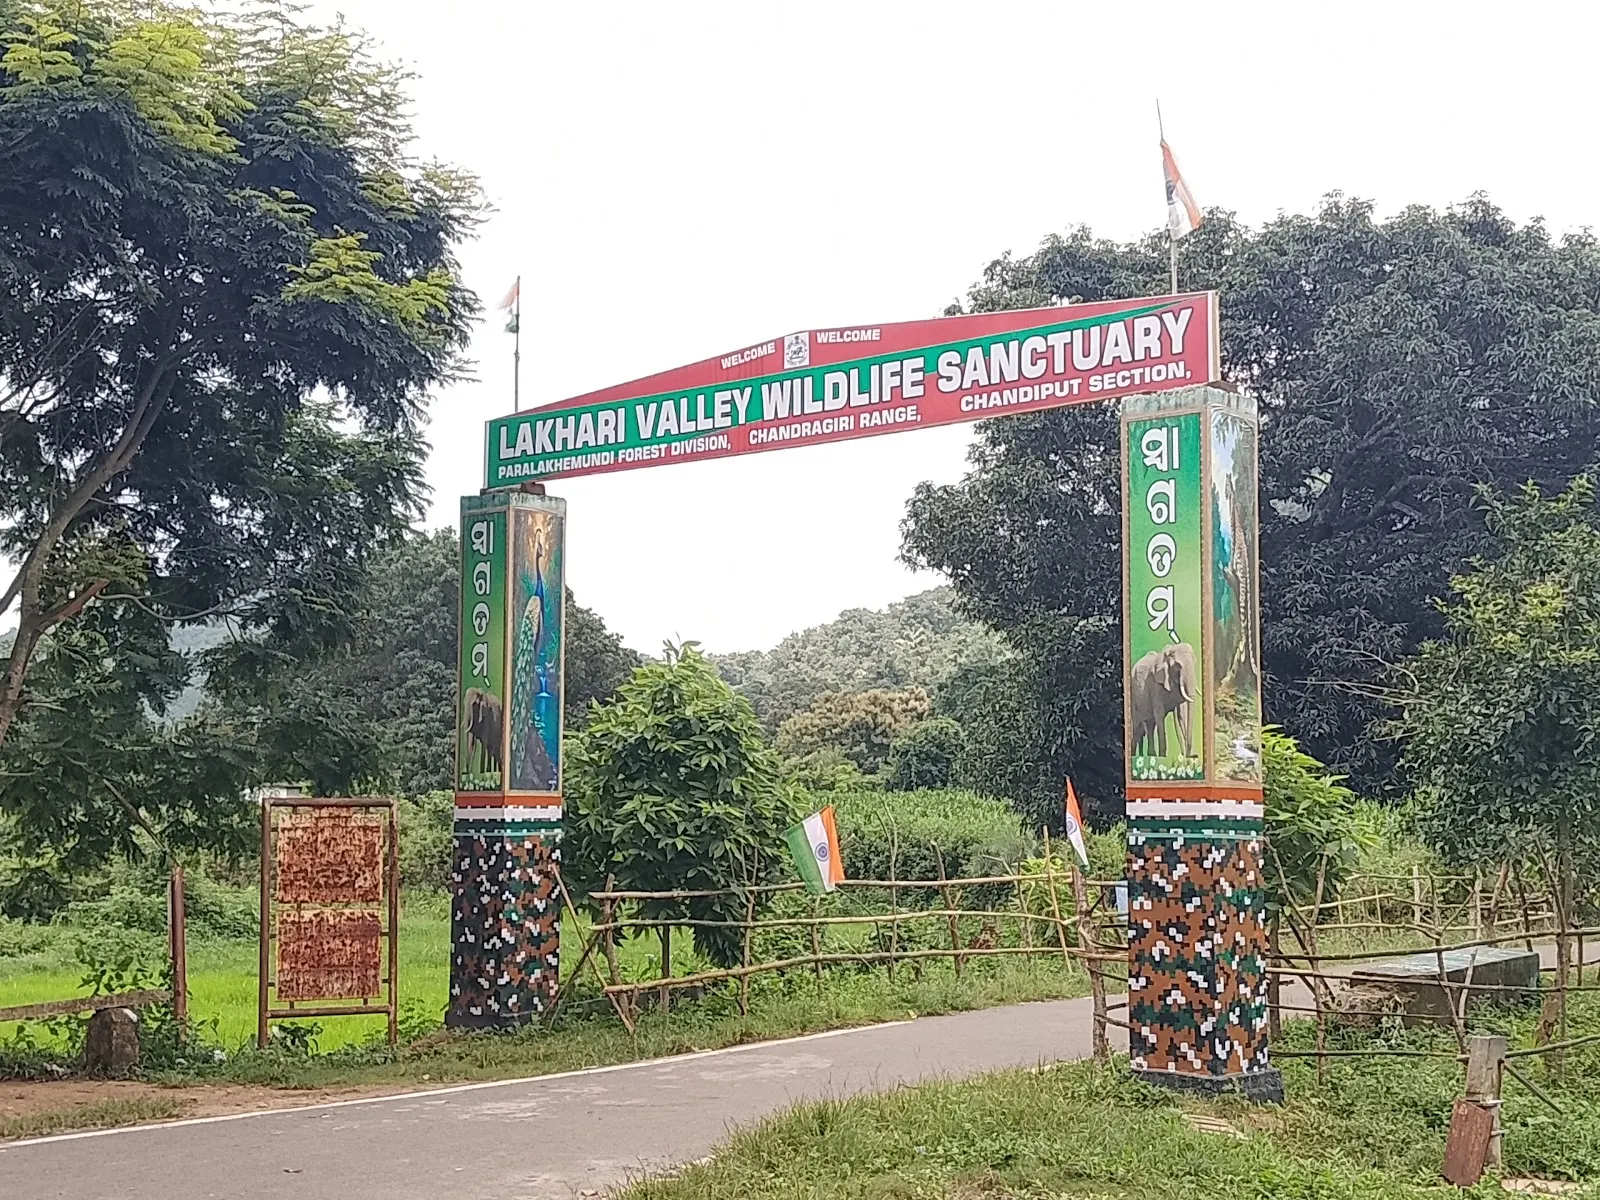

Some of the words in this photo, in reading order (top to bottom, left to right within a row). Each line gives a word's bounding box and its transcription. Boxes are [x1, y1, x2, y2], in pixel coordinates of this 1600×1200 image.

[721, 342, 776, 370] WELCOME
[816, 328, 881, 343] WELCOME
[499, 407, 626, 461] LAKHARI
[635, 386, 753, 440] VALLEY
[761, 356, 926, 422] WILDLIFE
[937, 307, 1193, 393] SANCTUARY
[960, 378, 1084, 412] CHANDIPUT
[1088, 360, 1192, 392] SECTION,
[749, 417, 855, 445] CHANDRAGIRI
[859, 405, 922, 429] RANGE,
[498, 451, 615, 480] PARALAKHEMUNDI
[617, 443, 668, 464] FOREST
[670, 434, 732, 457] DIVISION,
